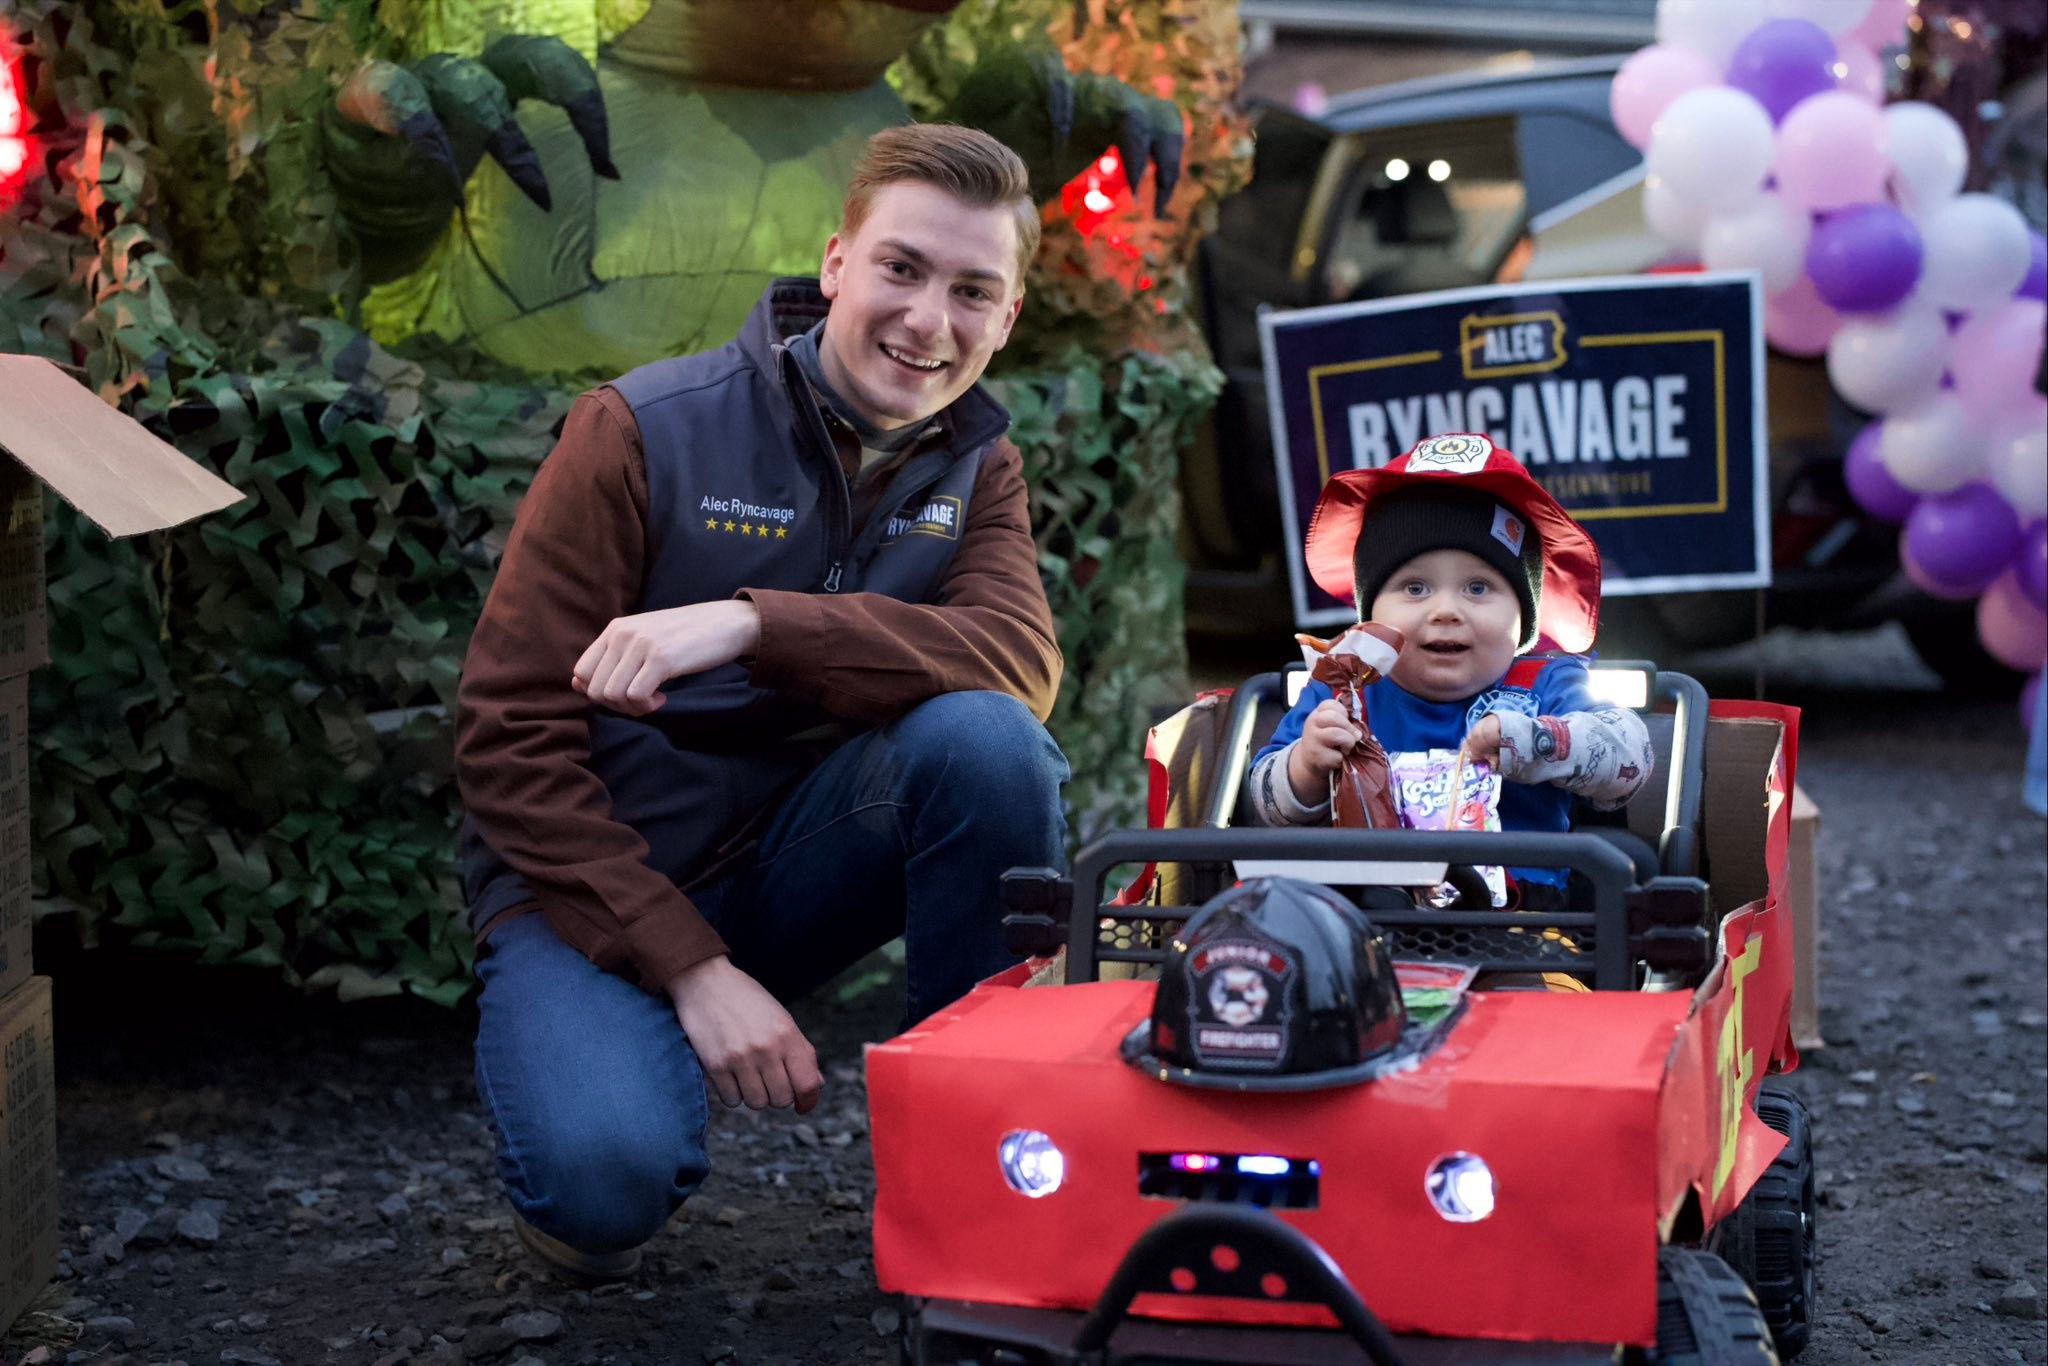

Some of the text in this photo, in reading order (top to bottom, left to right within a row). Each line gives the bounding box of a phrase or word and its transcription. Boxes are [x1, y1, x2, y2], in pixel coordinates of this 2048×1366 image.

[1484, 323, 1545, 364] ALEC
[700, 495, 795, 523] Alec Ryncavage
